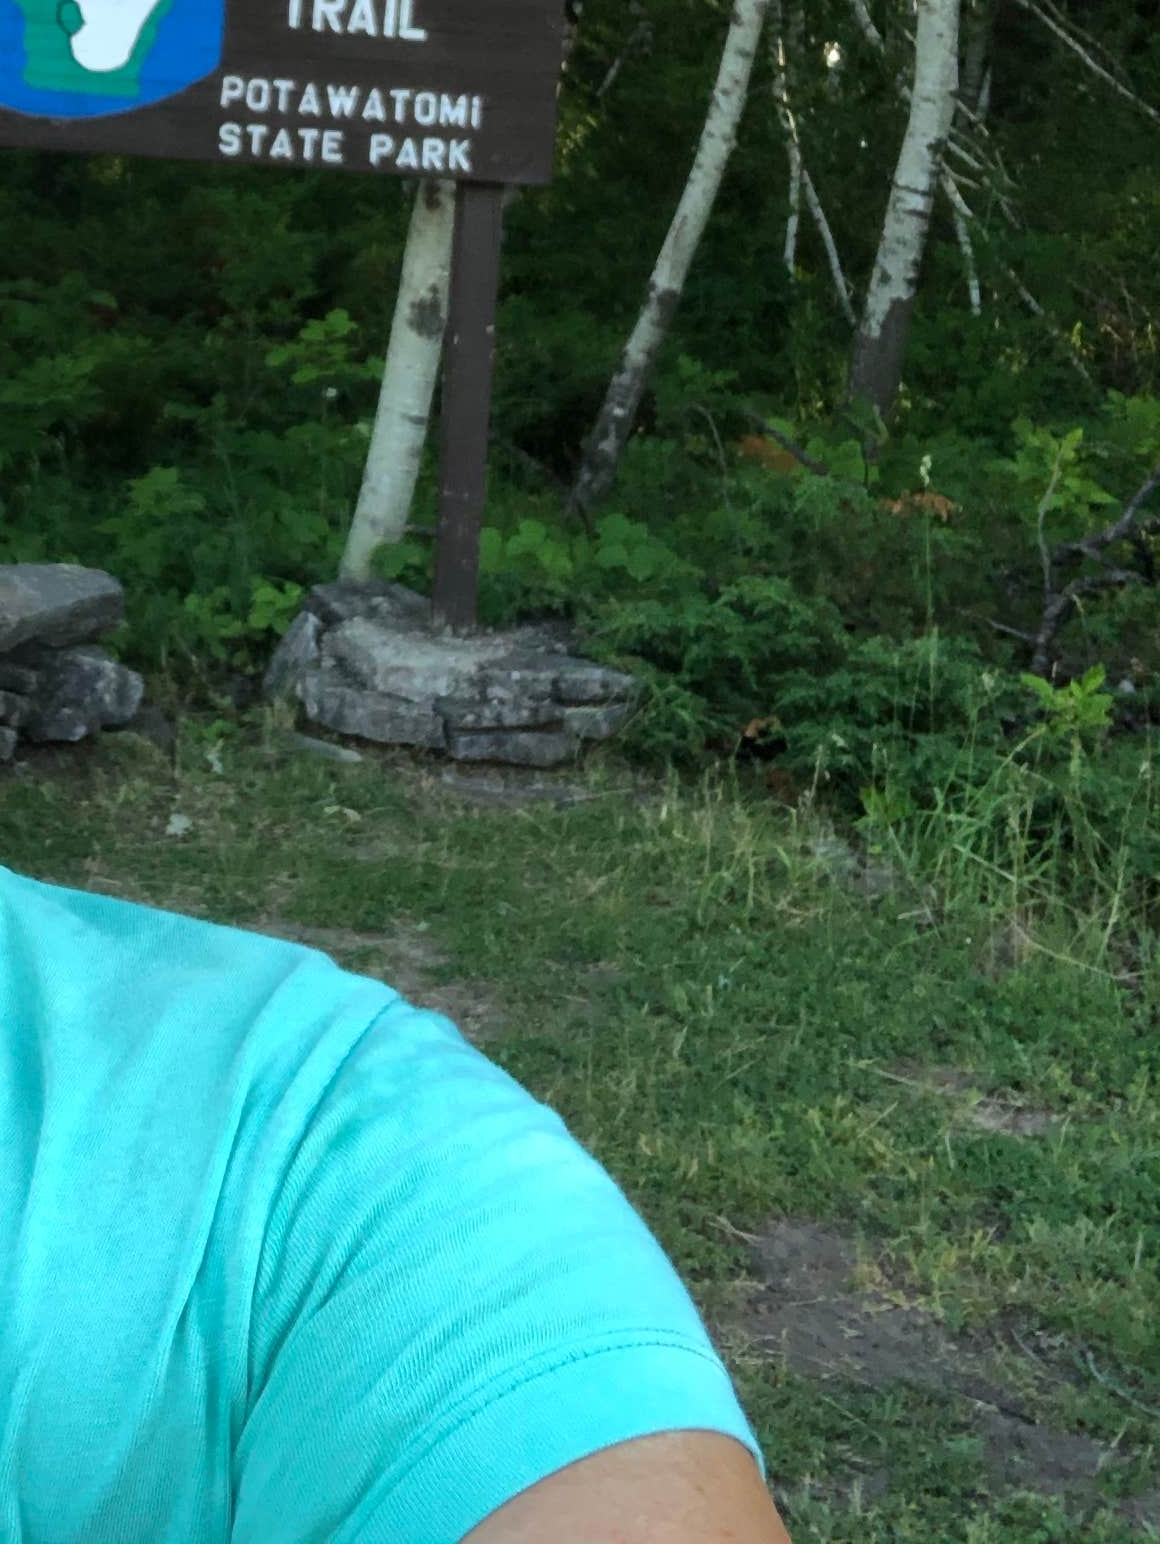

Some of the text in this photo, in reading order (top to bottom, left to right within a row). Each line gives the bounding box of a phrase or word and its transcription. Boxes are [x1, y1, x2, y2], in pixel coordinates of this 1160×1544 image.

[220, 75, 482, 129] POTAWATOMI
[218, 122, 472, 172] STATE PARK
